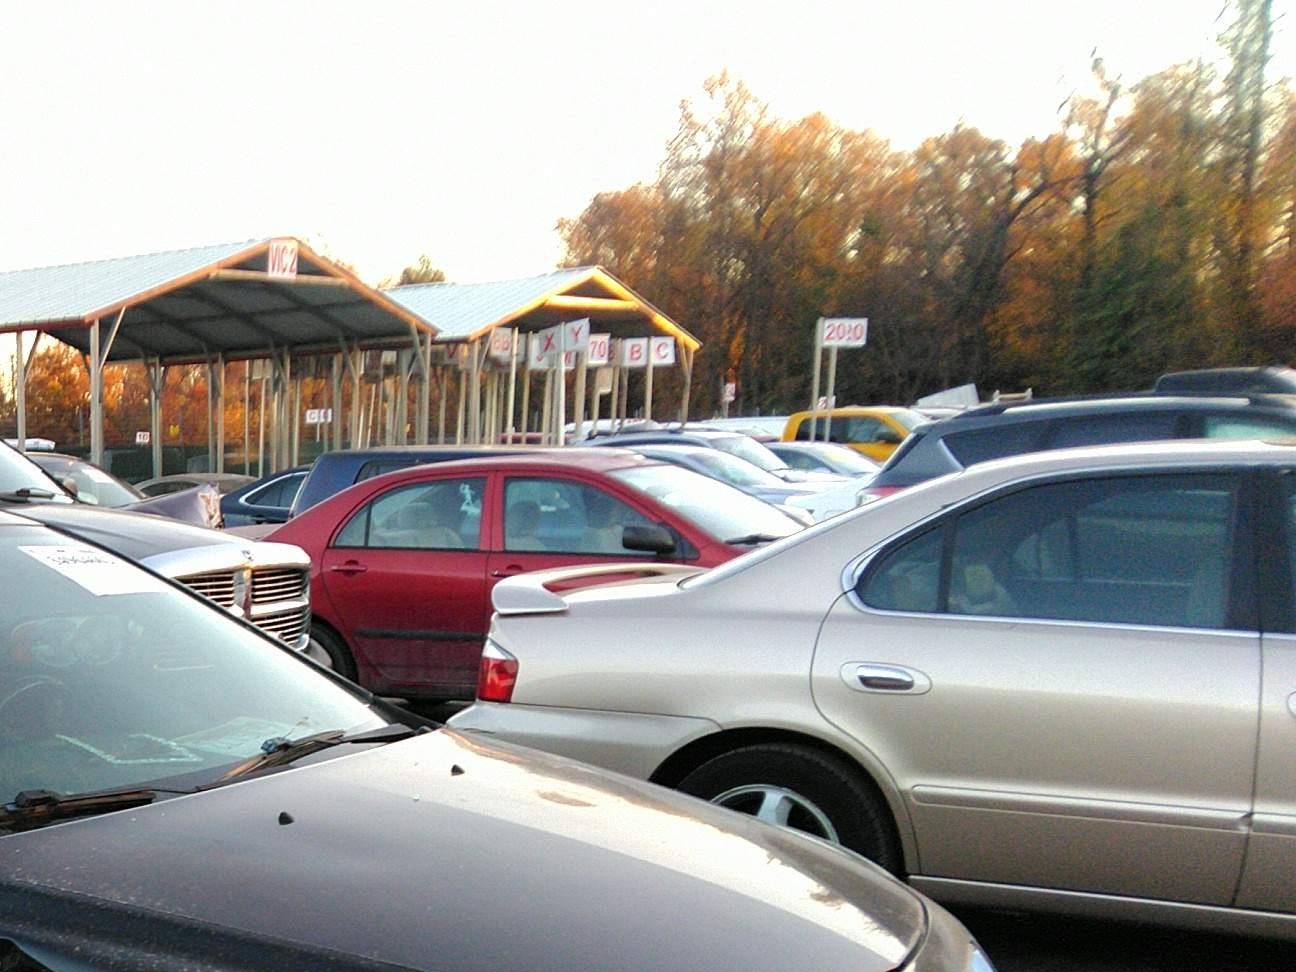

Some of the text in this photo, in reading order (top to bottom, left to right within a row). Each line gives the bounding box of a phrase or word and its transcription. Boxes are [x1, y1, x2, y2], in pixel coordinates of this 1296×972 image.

[570, 324, 582, 343] Y
[590, 340, 606, 358] 70
[630, 343, 642, 361] B
[655, 341, 669, 360] C
